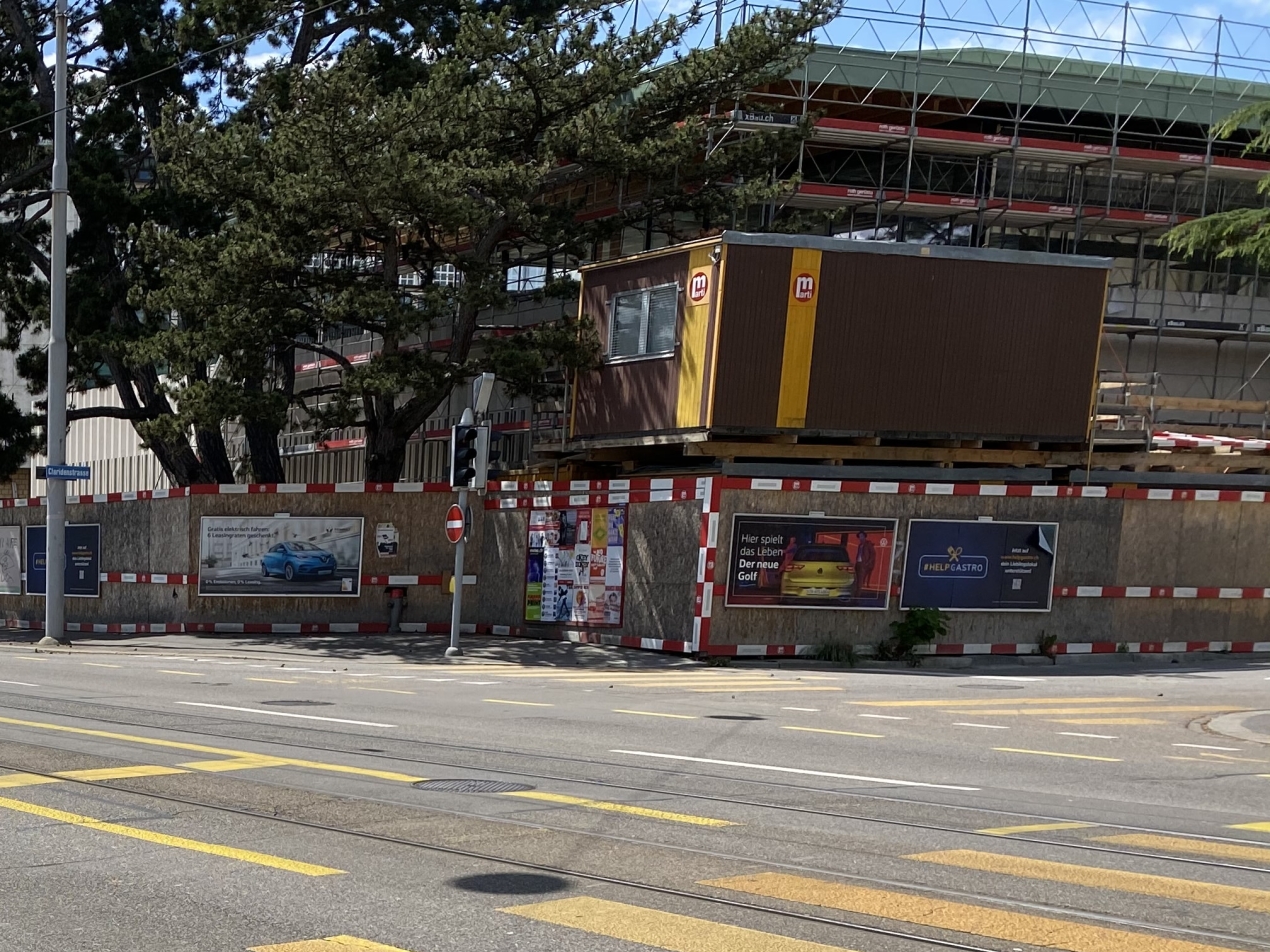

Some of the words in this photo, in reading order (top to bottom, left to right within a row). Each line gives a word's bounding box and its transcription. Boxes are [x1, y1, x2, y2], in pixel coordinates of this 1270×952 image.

[48, 467, 90, 477] Claridenstrasse
[741, 533, 760, 544] Hier
[760, 534, 784, 546] spielt
[740, 546, 756, 556] das
[757, 546, 784, 557] Leben
[739, 558, 756, 569] Der
[756, 561, 779, 569] neue
[737, 571, 758, 581] Golf
